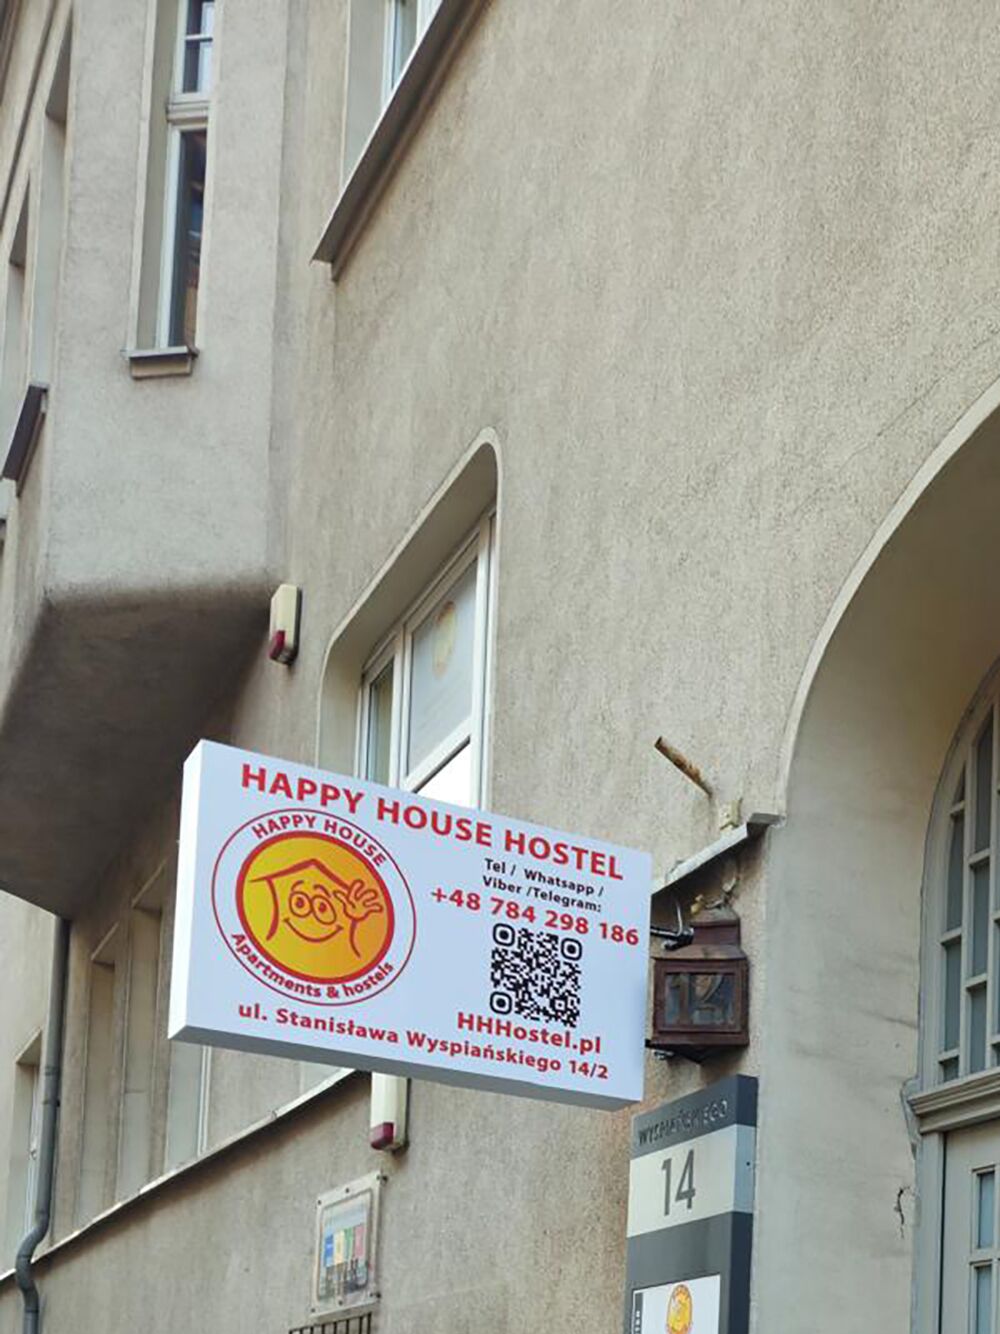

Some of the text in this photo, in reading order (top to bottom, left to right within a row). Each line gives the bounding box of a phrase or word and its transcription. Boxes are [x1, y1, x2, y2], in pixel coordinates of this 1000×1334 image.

[241, 763, 623, 880] HAPPY HOUSE HOSTEL
[252, 815, 387, 867] HAPPY HOUSE
[482, 875, 521, 894] Viber
[485, 858, 505, 874] Tel
[524, 869, 594, 896] Whatsapp
[431, 887, 639, 946] +48 784 298 186
[232, 933, 394, 998] Apartments & hostels
[239, 1003, 609, 1079] ul. Stanisława Wyspiańskiego 14/2
[457, 1011, 600, 1054] HHHostel.pl
[661, 1149, 696, 1216] 14
